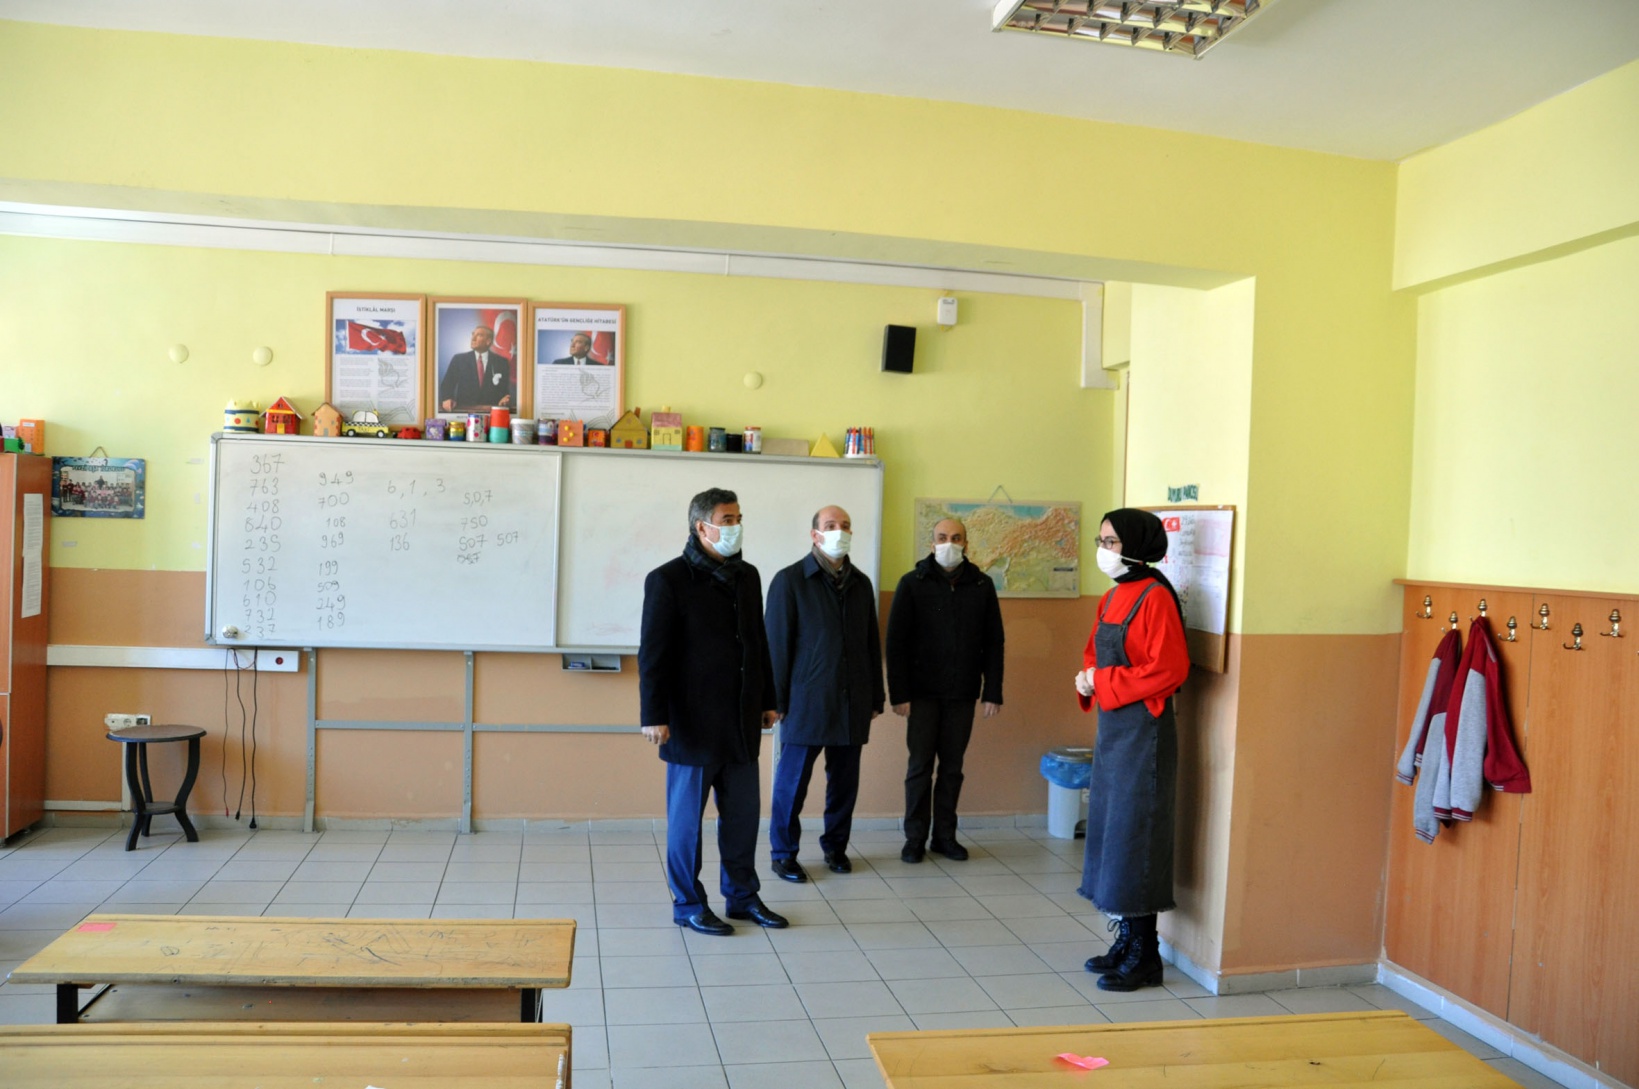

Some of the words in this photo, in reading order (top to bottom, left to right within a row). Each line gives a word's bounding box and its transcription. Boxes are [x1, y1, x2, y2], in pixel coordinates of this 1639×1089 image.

[250, 453, 285, 474] 367
[250, 477, 279, 496] 763
[319, 470, 354, 486] 949
[246, 499, 280, 514] 408
[318, 492, 350, 509] 700
[326, 516, 347, 528] 108
[389, 508, 416, 529] 631
[461, 515, 488, 531] 750
[245, 534, 281, 552] 235
[321, 531, 344, 549] 969
[389, 532, 410, 551] 136
[459, 534, 488, 552] 507
[496, 531, 519, 547] 507
[241, 556, 278, 574] 532
[319, 560, 339, 576] 199
[243, 576, 276, 591] 106
[317, 580, 340, 593] 509
[243, 591, 277, 608] 610
[316, 594, 346, 612] 249
[244, 608, 276, 623] 732
[317, 612, 346, 631] 189
[244, 624, 277, 638] 237
